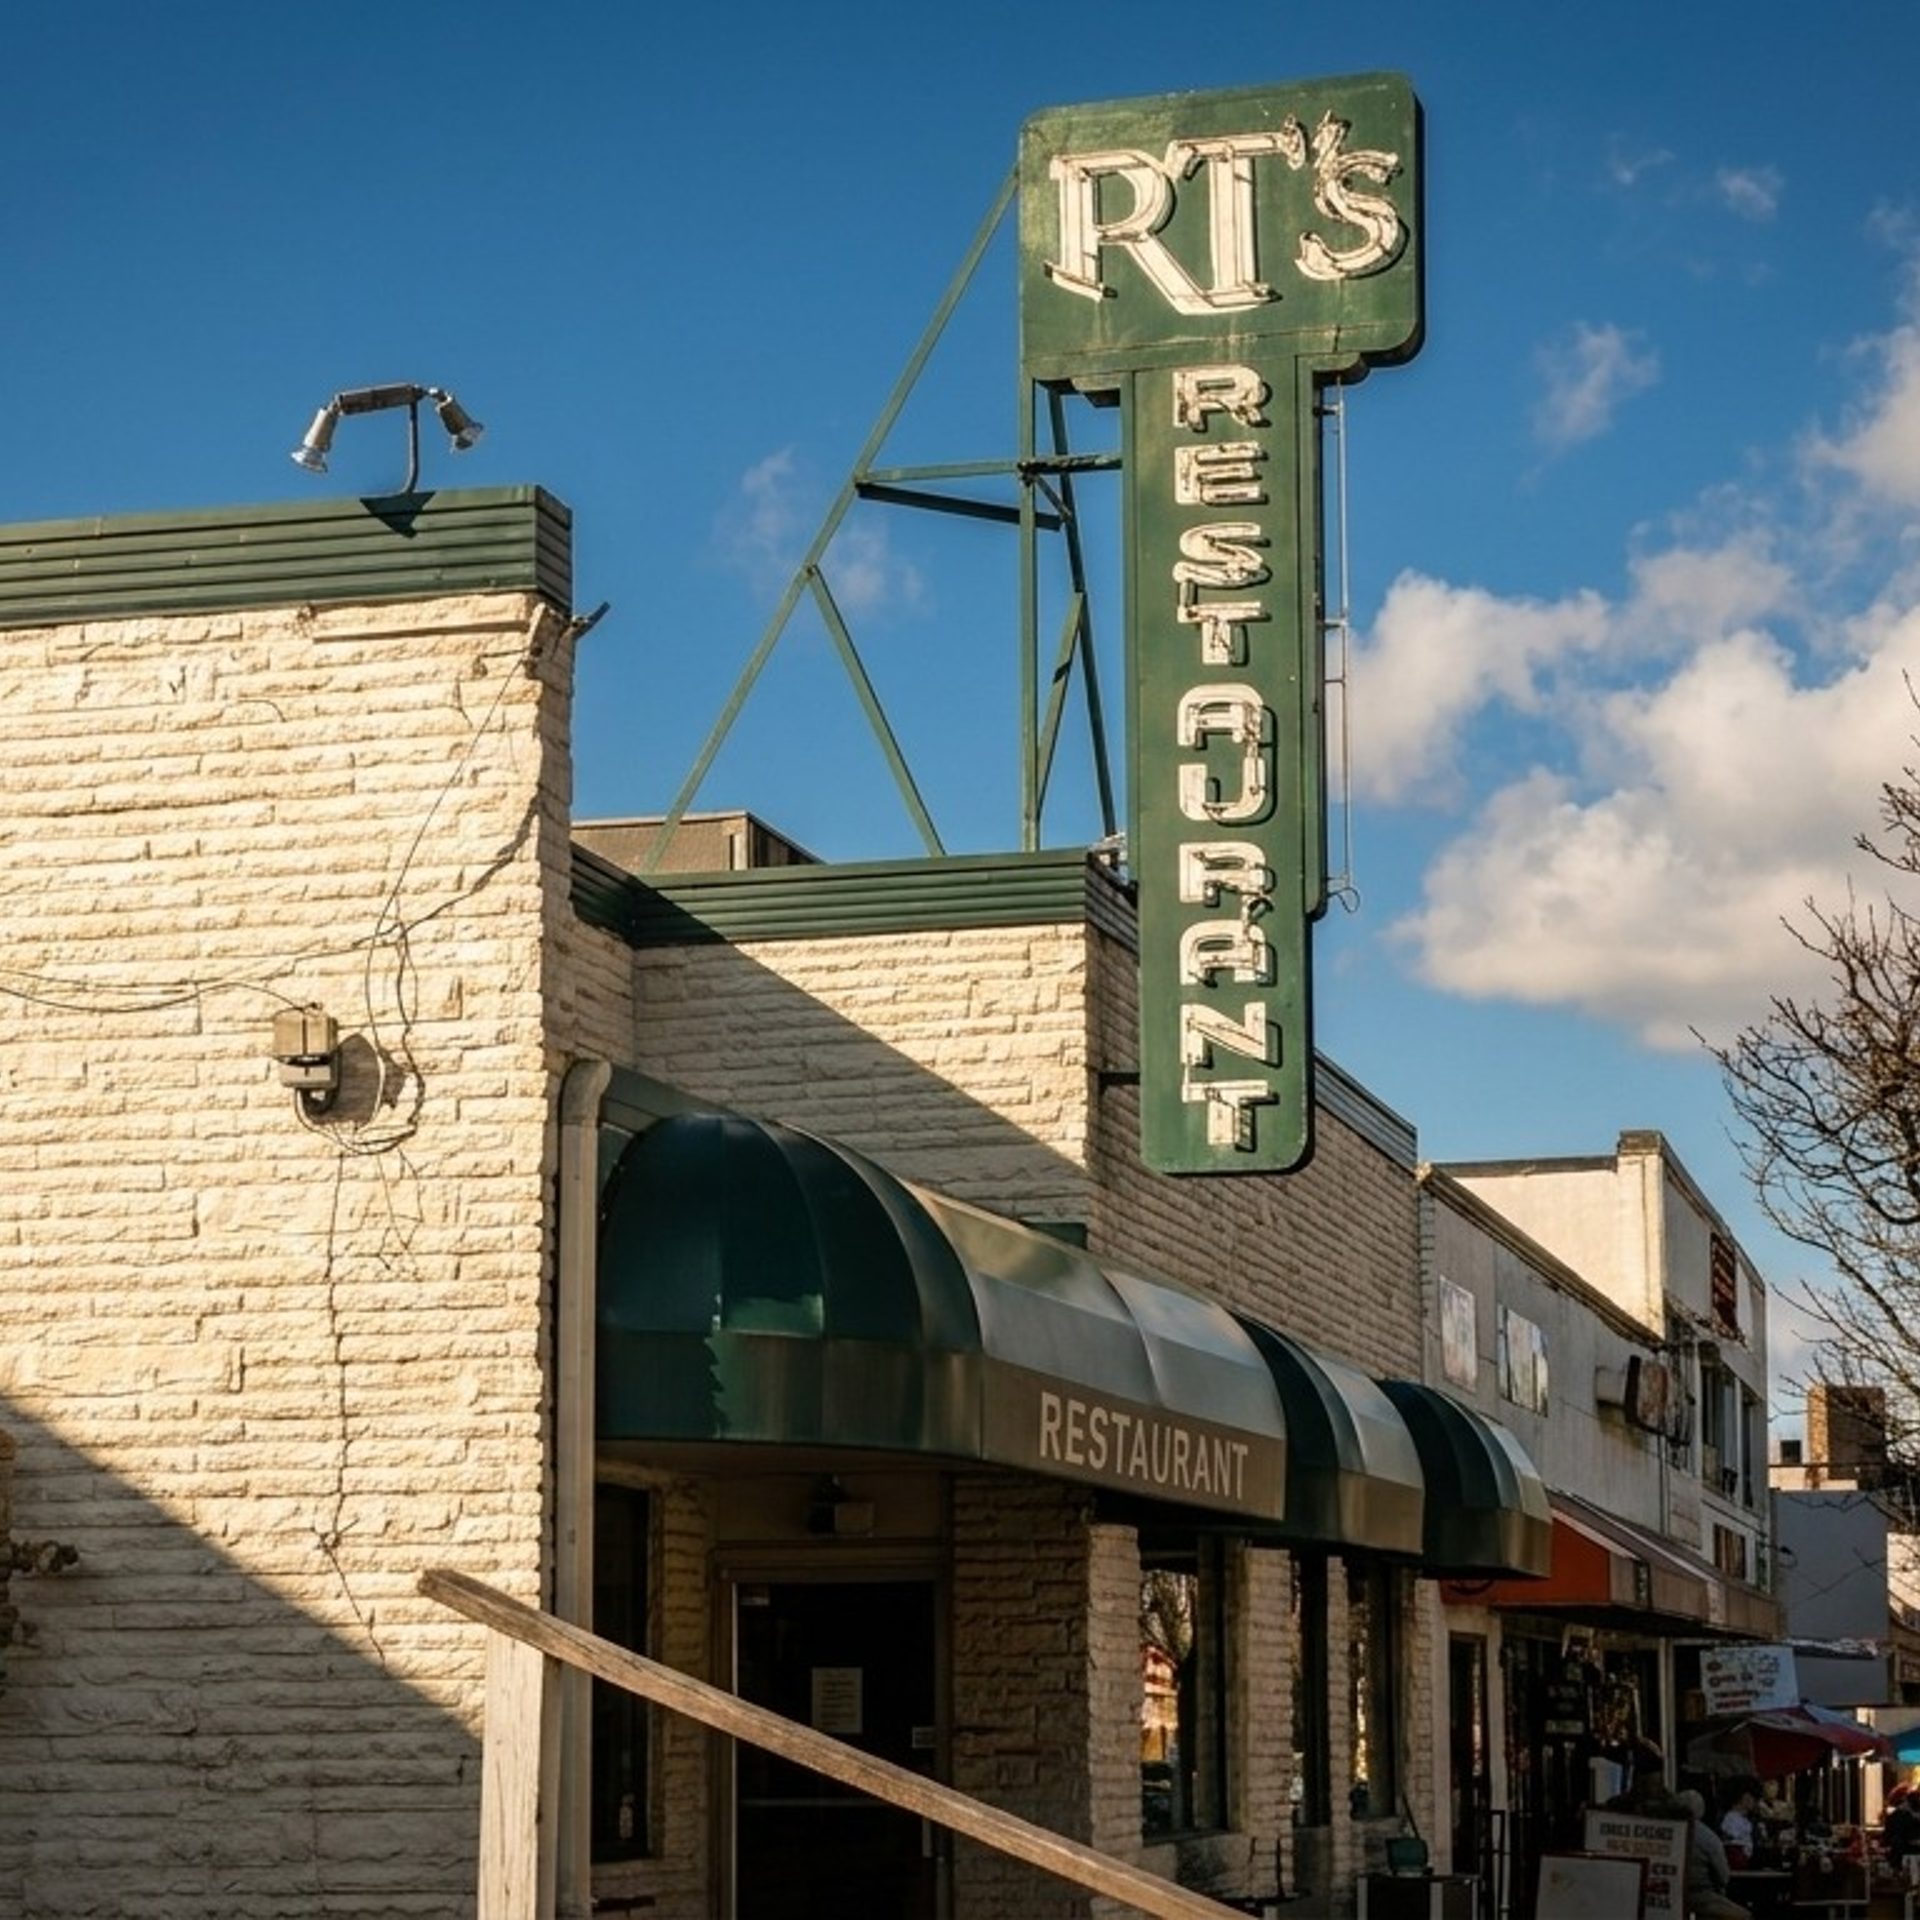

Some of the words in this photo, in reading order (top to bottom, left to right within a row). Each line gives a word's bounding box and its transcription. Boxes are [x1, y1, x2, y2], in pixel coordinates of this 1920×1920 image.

[1044, 110, 1403, 315] RT's
[1173, 364, 1270, 1148] RESTAURANT
[1039, 1391, 1249, 1500] RESTAURANT
